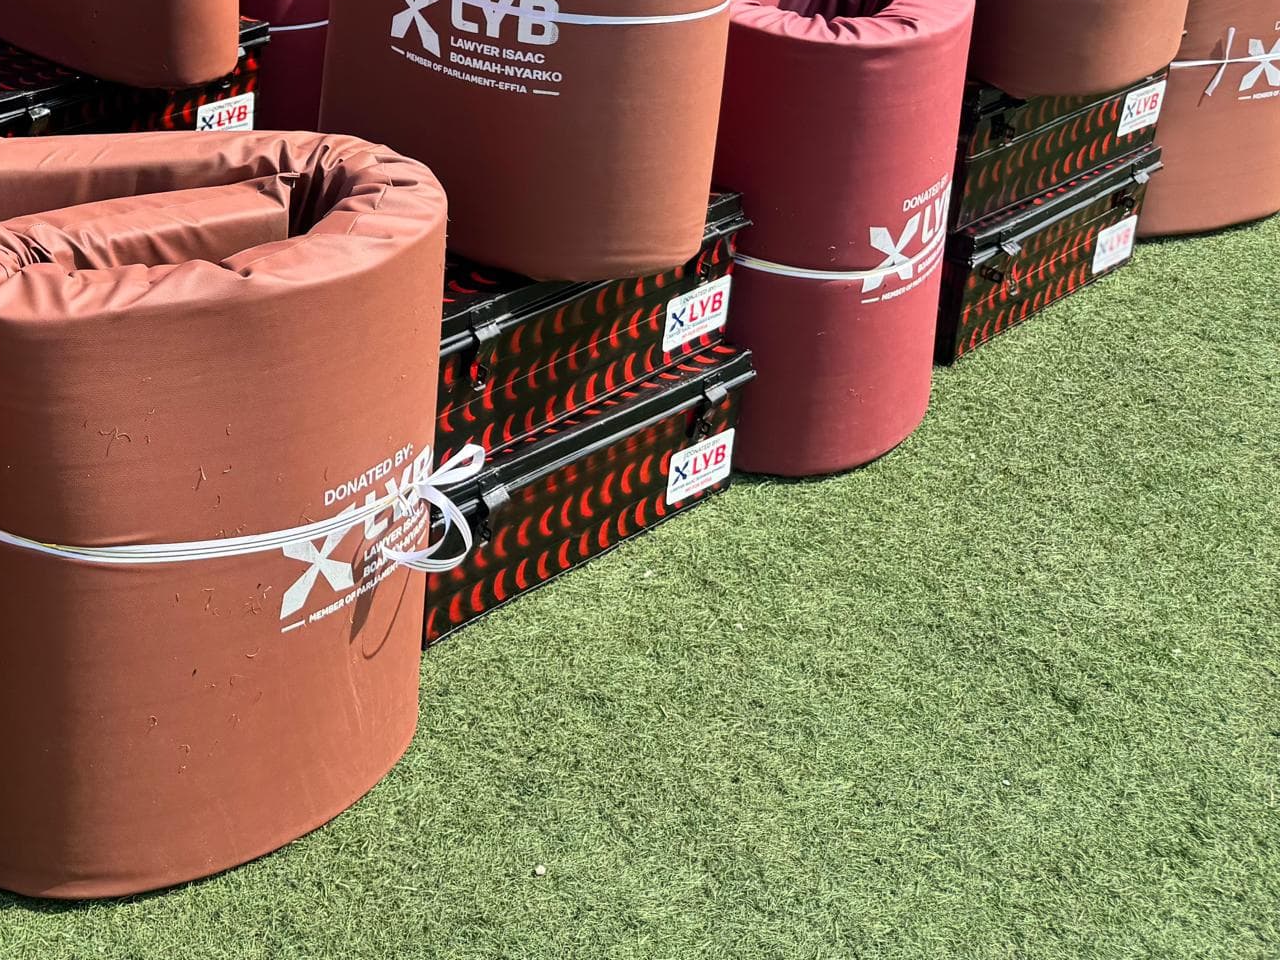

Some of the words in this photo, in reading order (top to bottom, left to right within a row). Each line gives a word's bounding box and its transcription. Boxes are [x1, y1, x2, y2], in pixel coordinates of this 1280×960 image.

[450, 36, 500, 57] LAWYER
[502, 48, 545, 64] ISAAC
[406, 51, 432, 68] MEMBER
[433, 62, 443, 72] OF
[443, 66, 528, 94] PARLIAMENT-EFFIA
[449, 51, 563, 83] BOAMAH-NYARKO
[216, 105, 247, 127] LYB
[1136, 93, 1159, 115] LYB
[903, 186, 939, 212] DONATED
[689, 290, 723, 323] LYB
[881, 285, 906, 301] MEMBER
[324, 458, 392, 506] DONATED
[395, 442, 413, 467] BY:
[692, 444, 726, 475] LYB
[308, 595, 344, 623] MEMBER
[345, 588, 356, 603] OF
